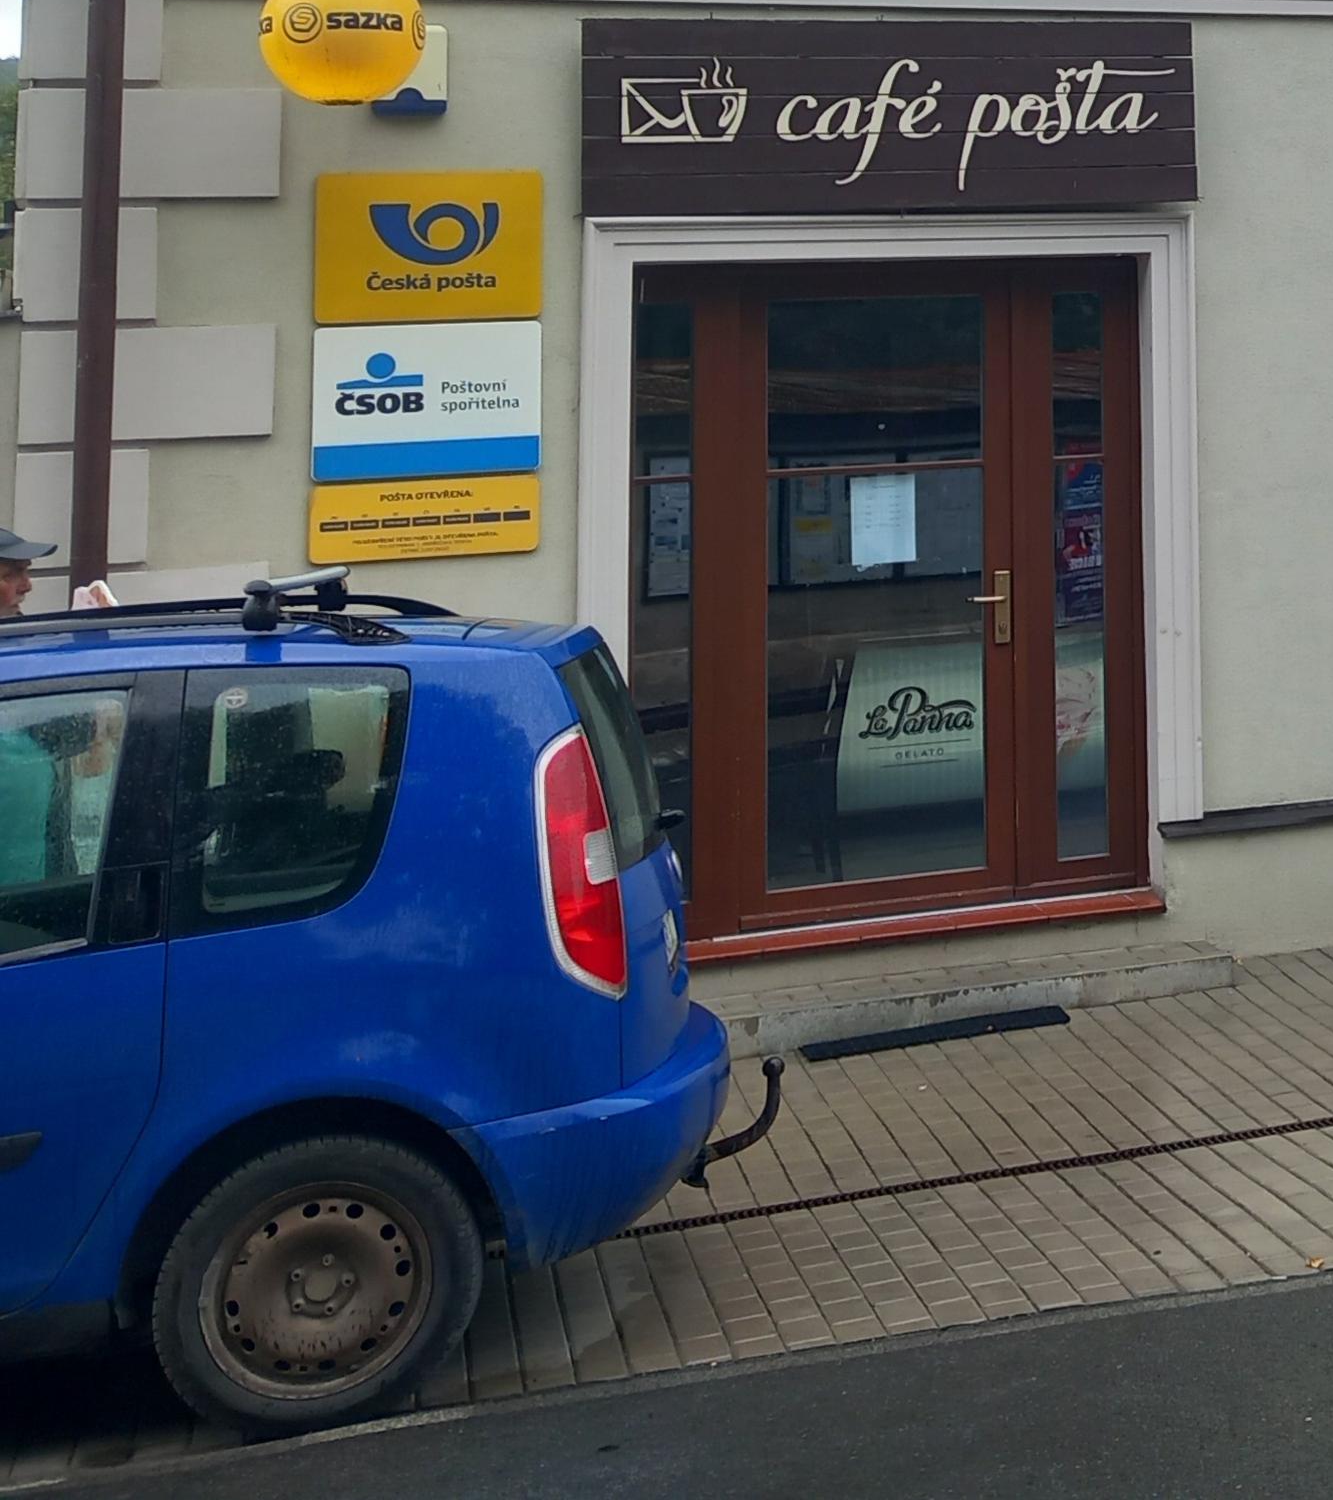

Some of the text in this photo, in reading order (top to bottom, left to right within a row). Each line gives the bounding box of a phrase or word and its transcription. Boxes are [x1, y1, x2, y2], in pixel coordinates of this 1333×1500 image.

[326, 11, 403, 32] sazka
[776, 58, 1175, 191] café pošta
[366, 271, 497, 292] Česká pošta
[335, 379, 507, 416] ČSOB Poštovní
[441, 396, 520, 413] spořitelna
[380, 492, 413, 502] POŠTA
[858, 686, 977, 740] La Panna
[895, 748, 944, 760] GELATO
